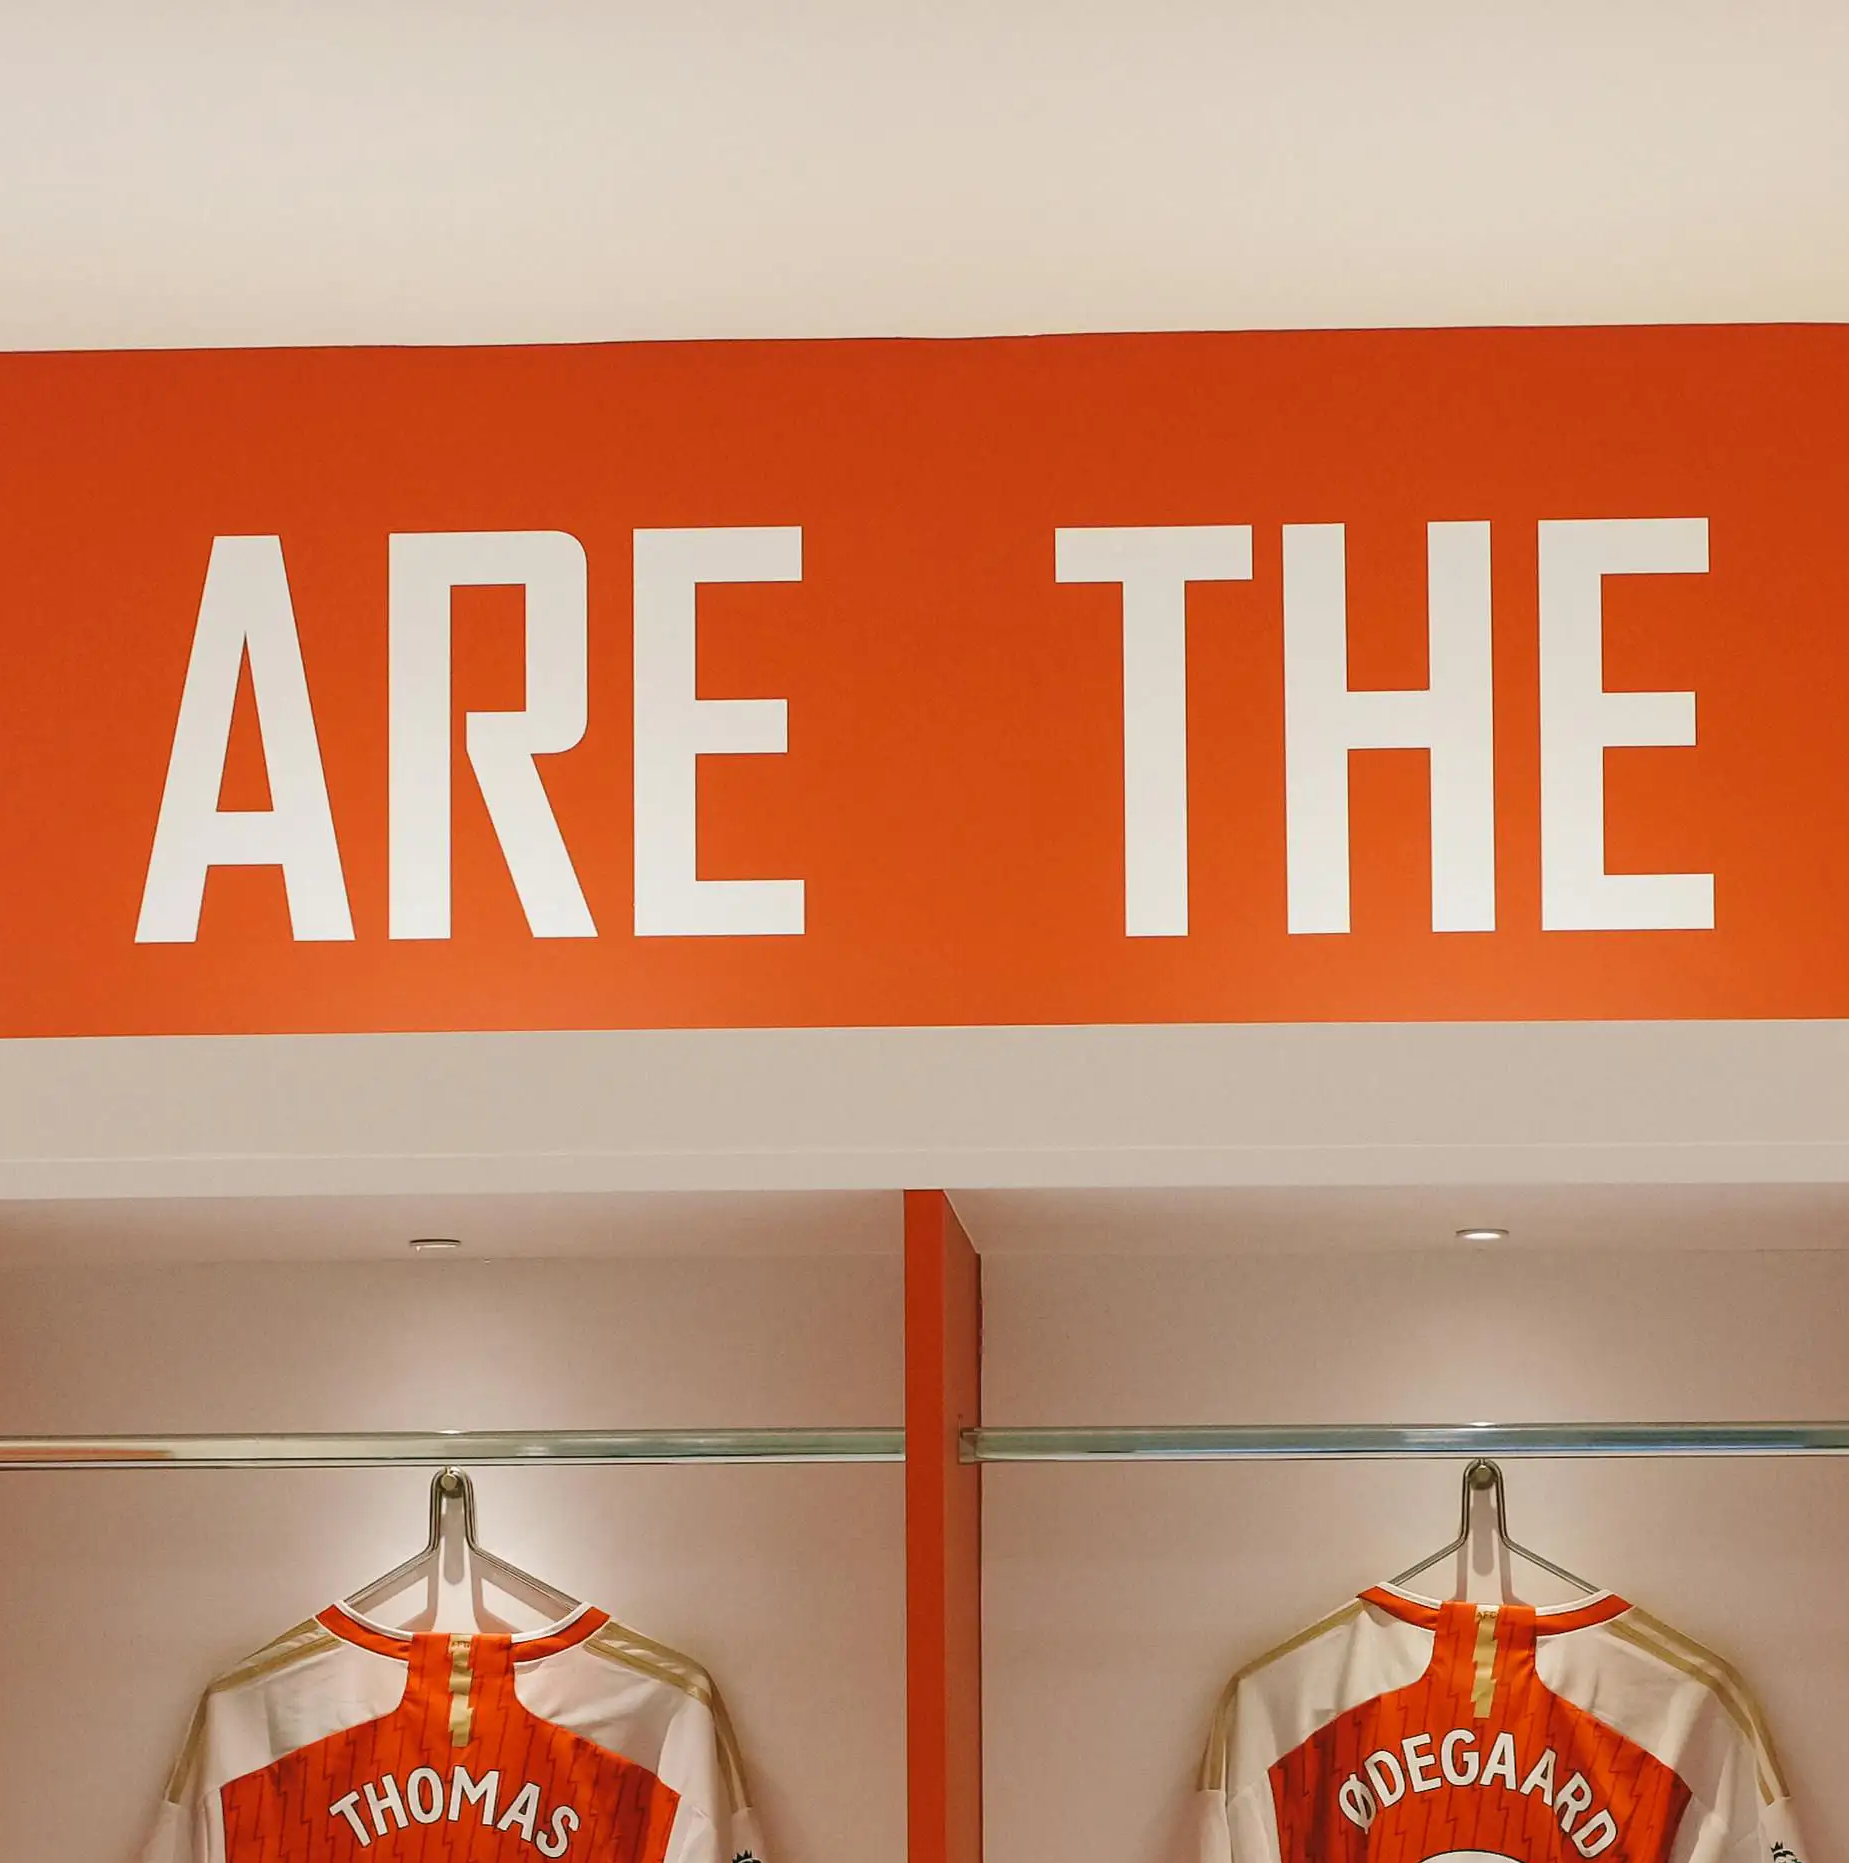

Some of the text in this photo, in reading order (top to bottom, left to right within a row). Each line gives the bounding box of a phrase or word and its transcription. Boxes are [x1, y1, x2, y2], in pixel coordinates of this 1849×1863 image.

[134, 526, 806, 944] ARE
[1054, 517, 1716, 938] THE
[328, 1764, 581, 1860] THOMAS
[1338, 1728, 1618, 1860] ØDEGAARD
